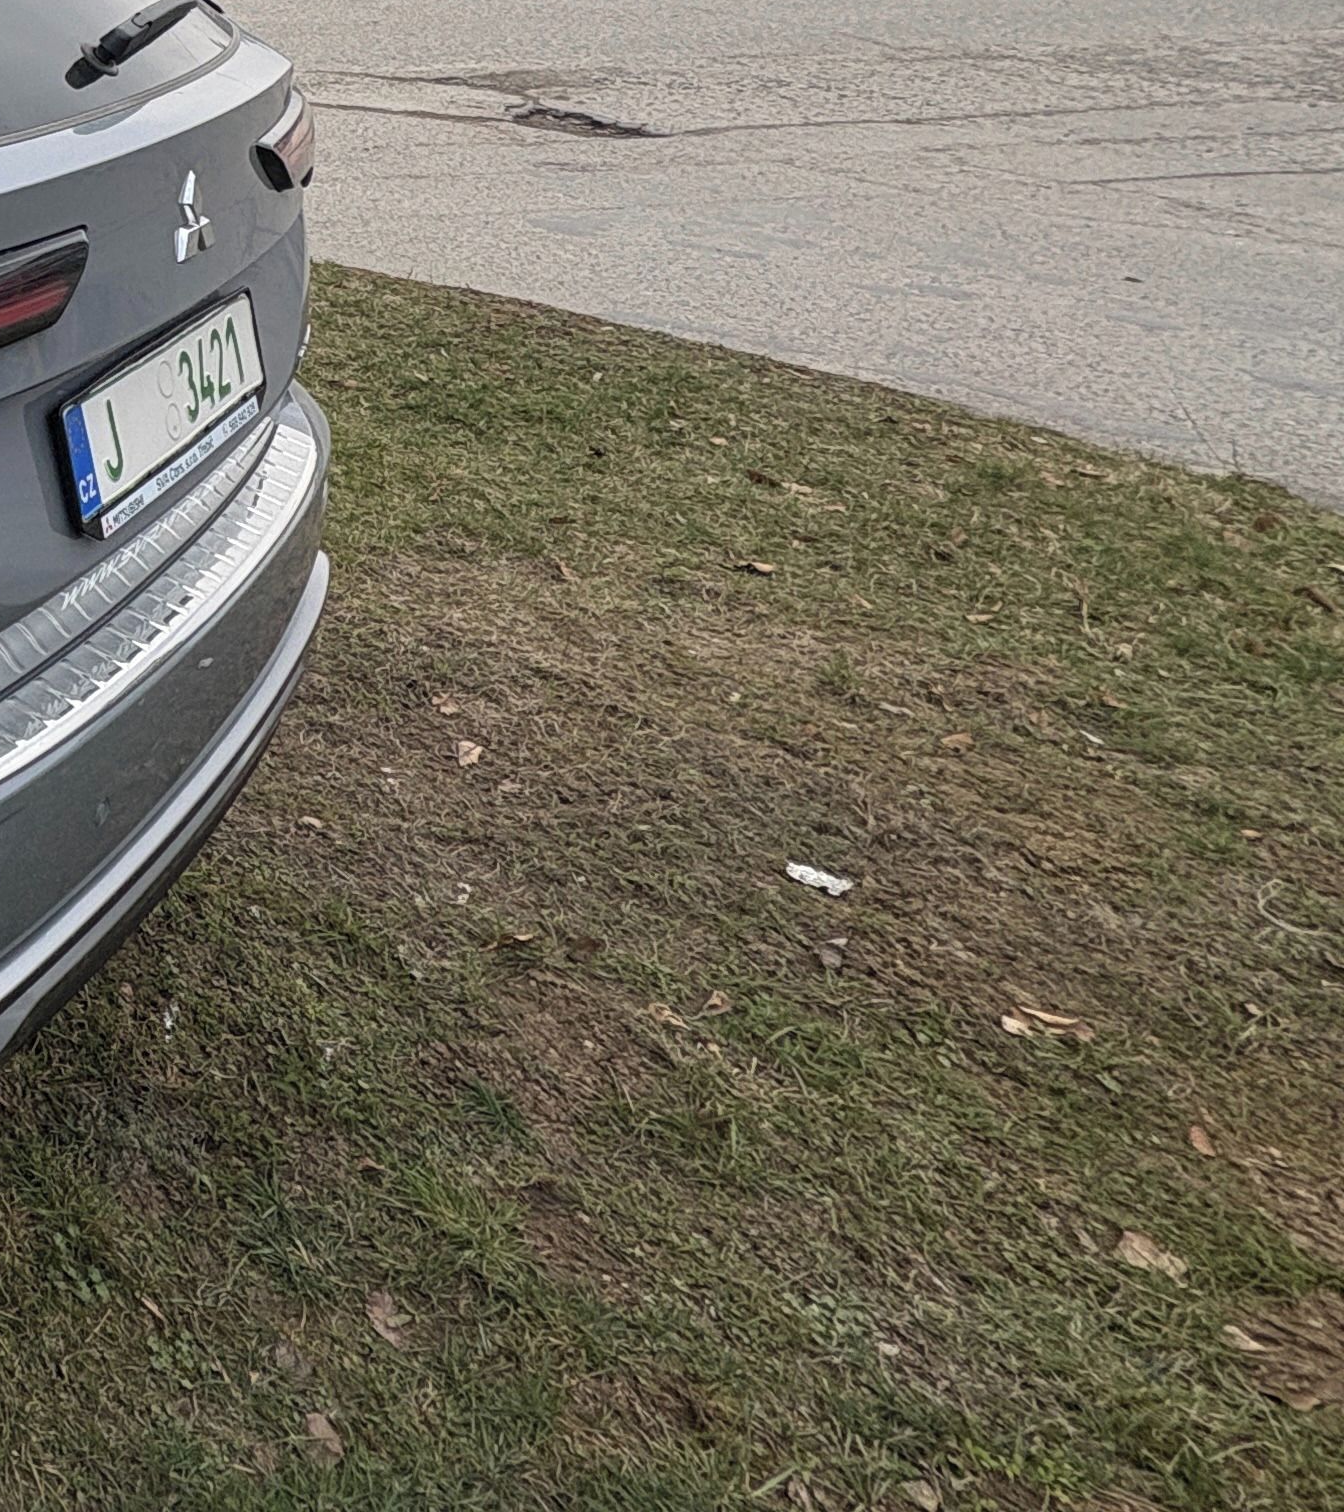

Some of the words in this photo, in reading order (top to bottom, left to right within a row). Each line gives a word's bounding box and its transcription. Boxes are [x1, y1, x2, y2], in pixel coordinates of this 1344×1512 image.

[104, 398, 124, 483] J
[177, 314, 245, 424] 3421
[77, 473, 97, 503] CZ
